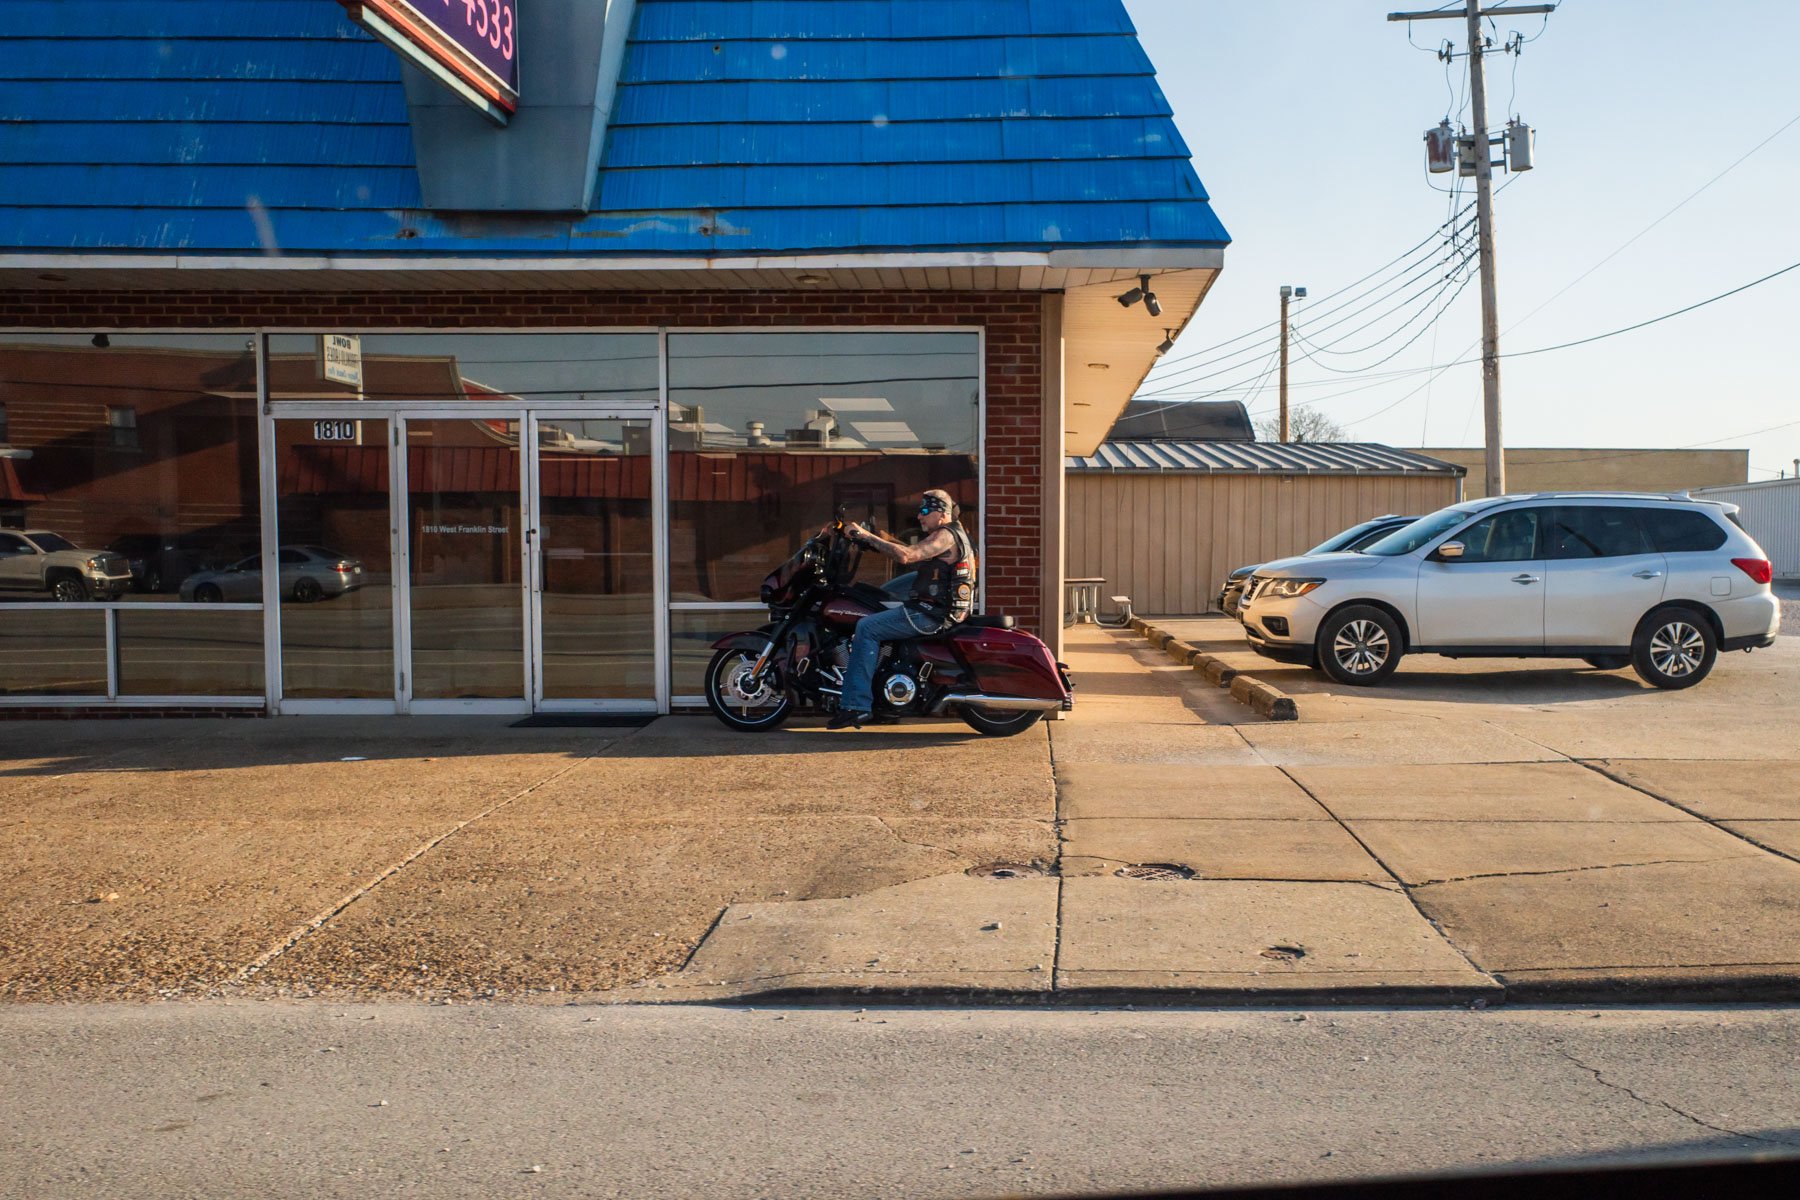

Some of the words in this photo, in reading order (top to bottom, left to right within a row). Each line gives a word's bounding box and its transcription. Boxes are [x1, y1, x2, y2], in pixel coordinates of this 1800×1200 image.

[314, 421, 354, 440] 1810
[422, 525, 438, 533] 1810
[440, 525, 457, 533] West
[458, 525, 487, 533] Franklin
[488, 525, 509, 533] Street
